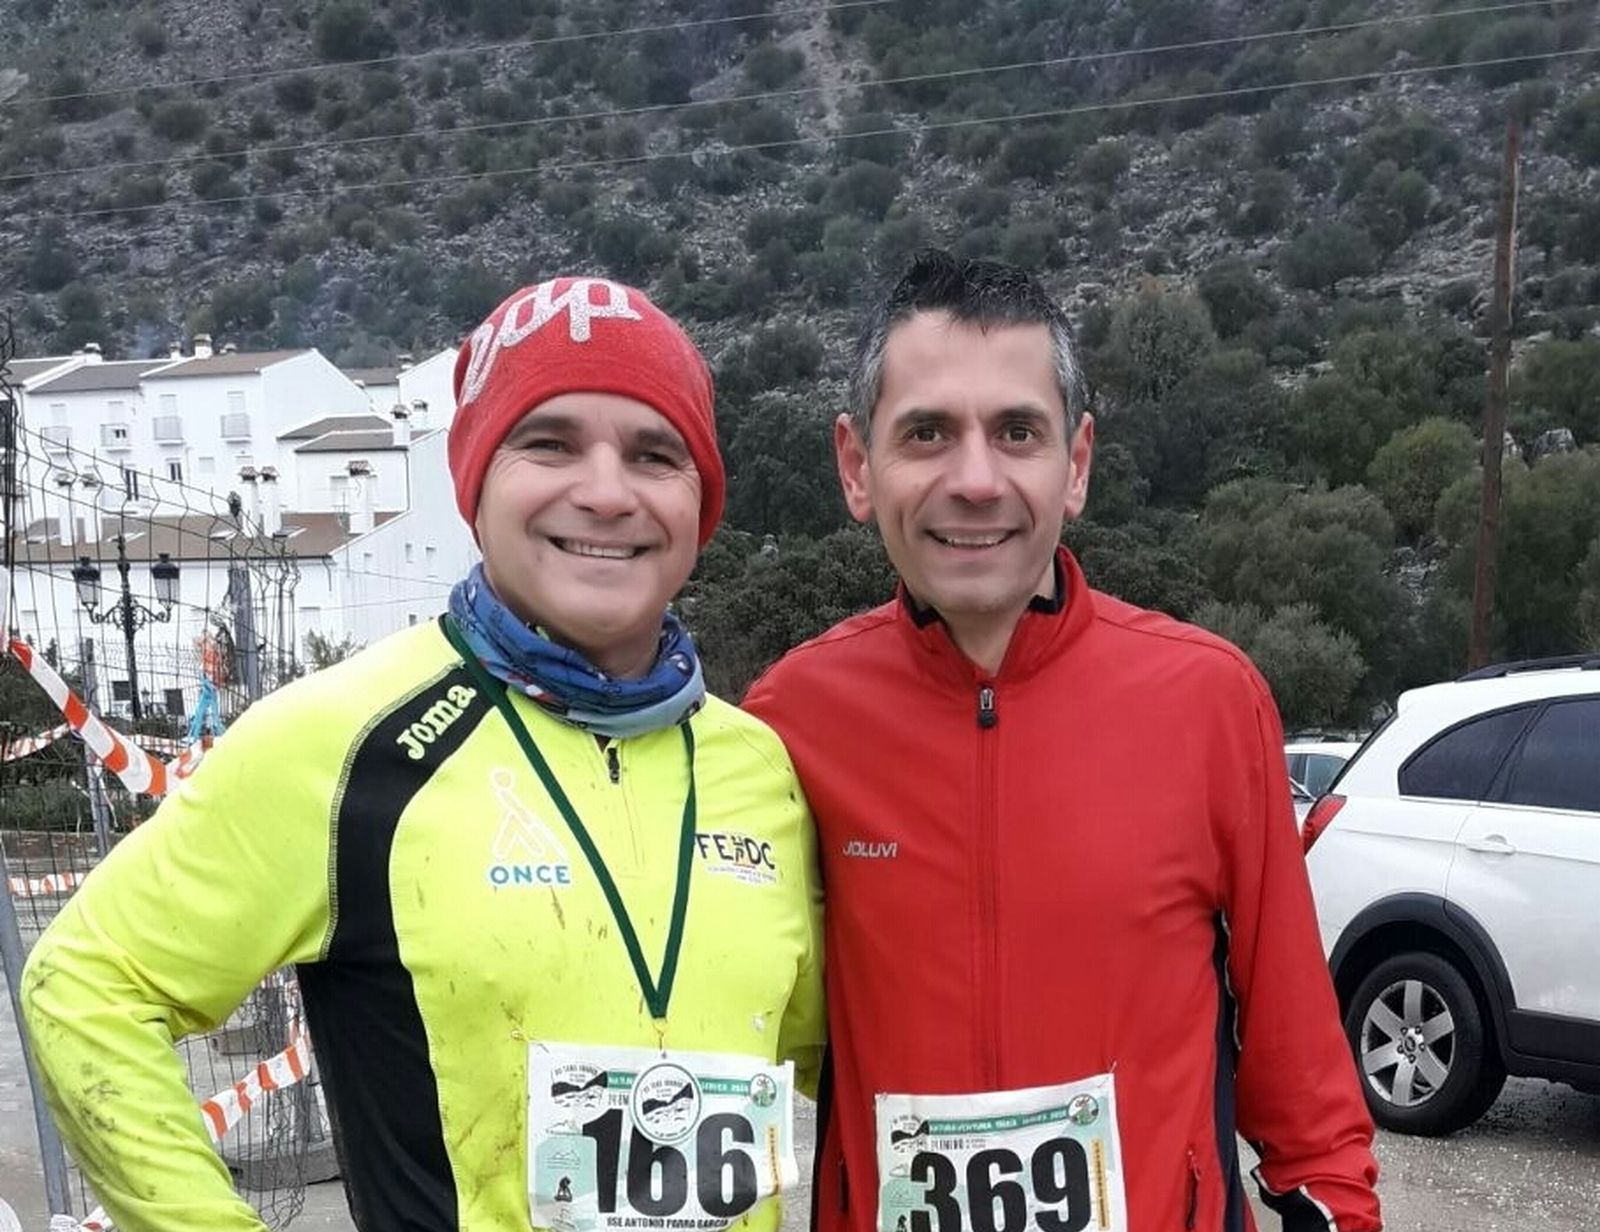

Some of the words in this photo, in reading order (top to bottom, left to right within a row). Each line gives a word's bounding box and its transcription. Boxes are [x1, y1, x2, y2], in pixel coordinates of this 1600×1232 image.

[396, 684, 478, 760] Joma
[842, 840, 898, 858] JOLUVI
[490, 865, 571, 885] ONCE
[582, 1108, 758, 1218] 166
